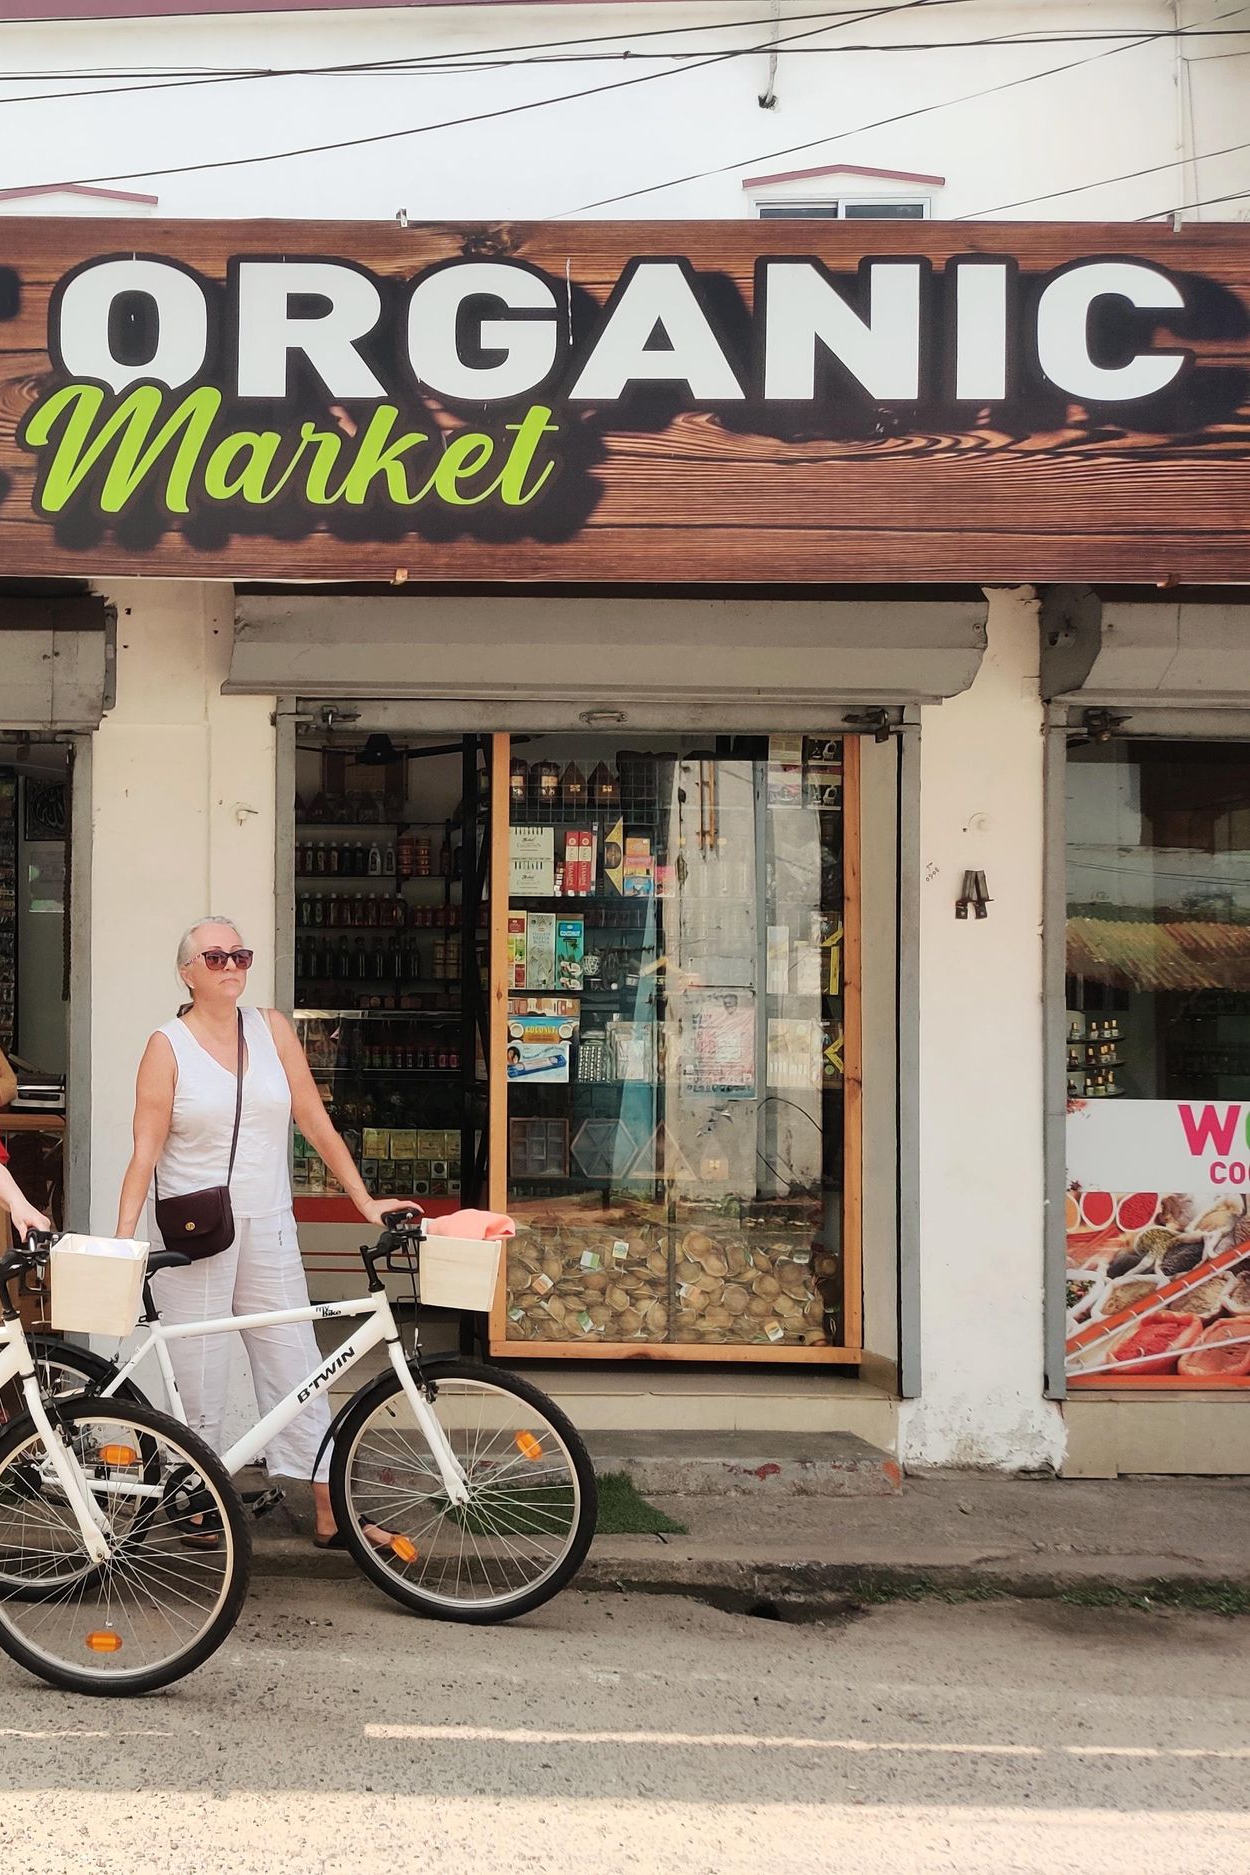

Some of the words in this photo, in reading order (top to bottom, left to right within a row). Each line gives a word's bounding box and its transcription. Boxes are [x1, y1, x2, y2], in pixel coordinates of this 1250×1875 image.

[59, 260, 1191, 402] ORGANIC
[23, 384, 564, 514] Market
[1177, 1104, 1250, 1156] W
[1209, 1161, 1250, 1185] CO
